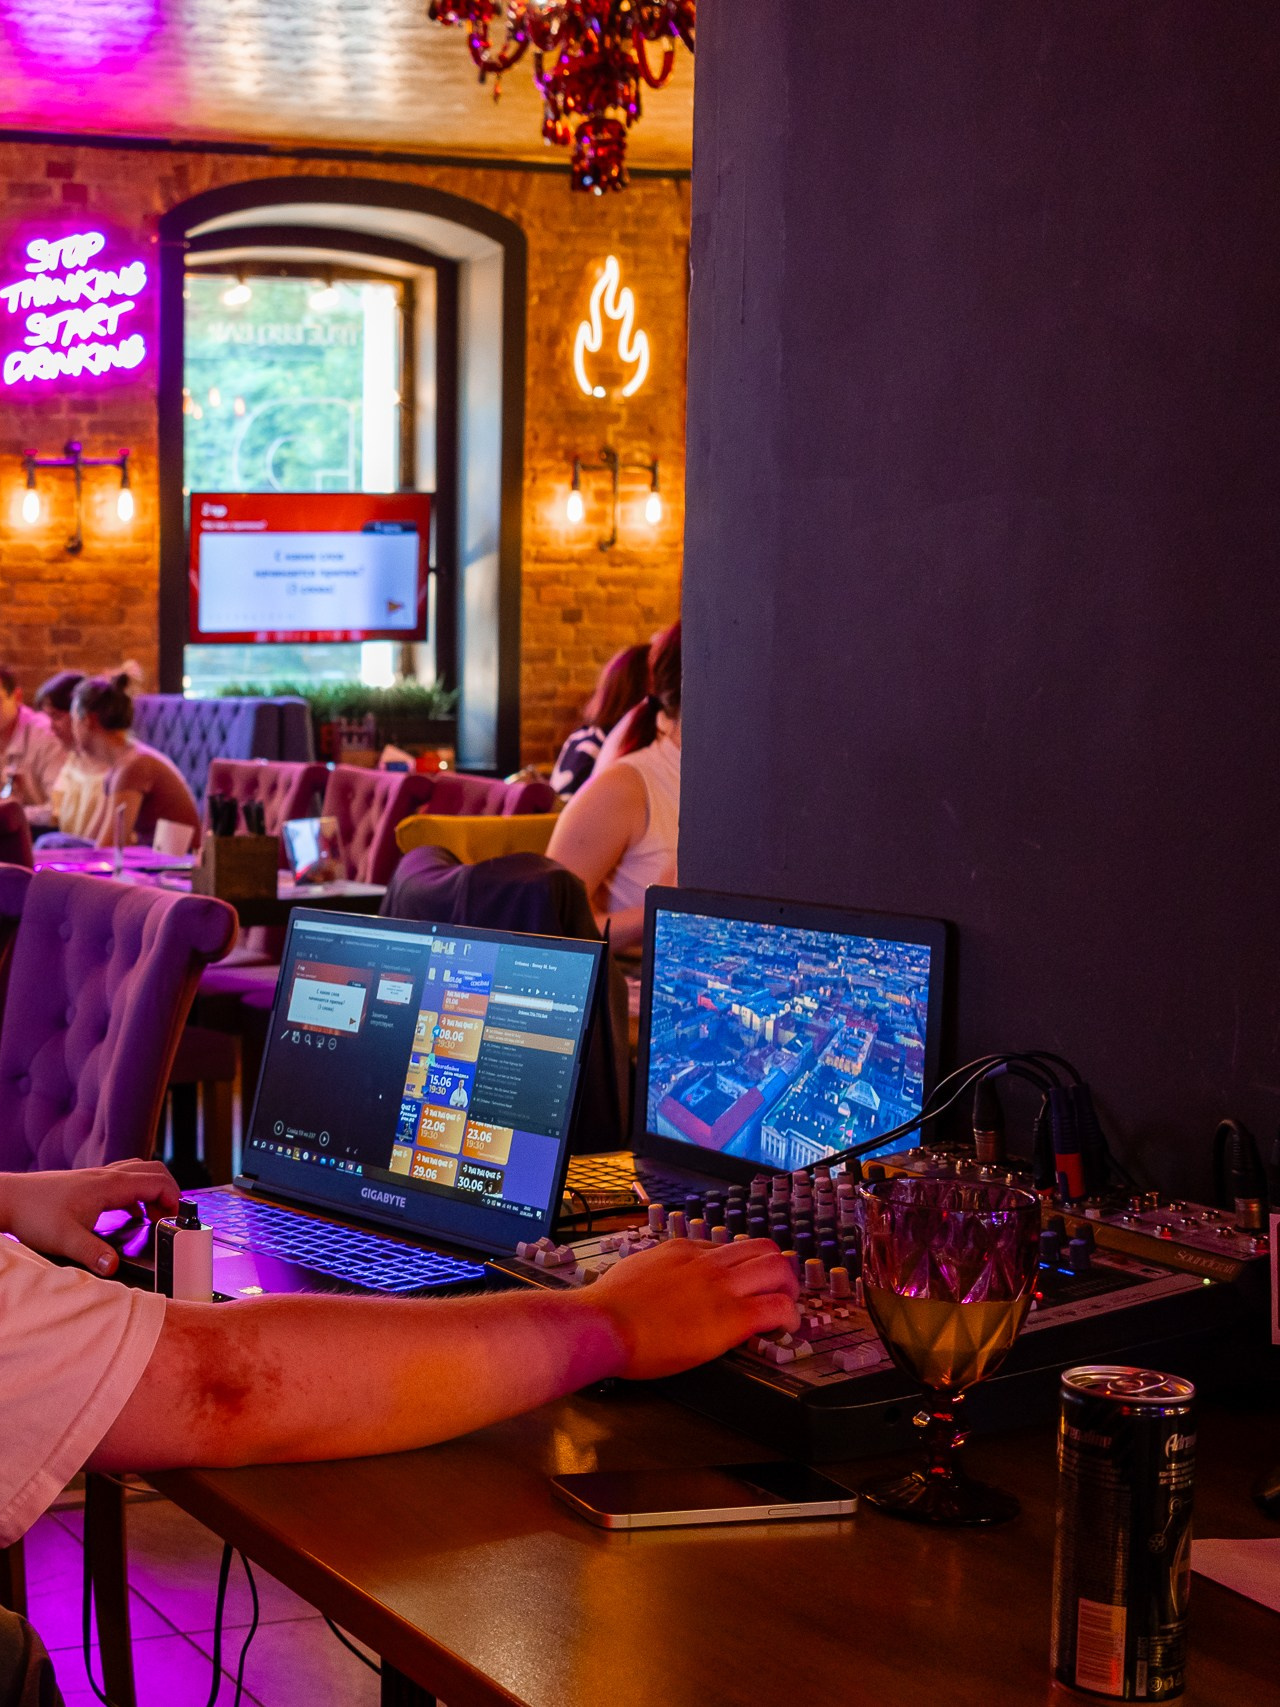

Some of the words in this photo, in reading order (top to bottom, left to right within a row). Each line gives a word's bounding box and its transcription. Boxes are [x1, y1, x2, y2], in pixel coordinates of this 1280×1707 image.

[25, 231, 105, 273] STOP
[0, 261, 147, 313] THINKING
[24, 300, 135, 346] START
[3, 334, 145, 385] DRINKING
[439, 1029, 464, 1042] 08.06
[430, 1074, 452, 1087] 15.06
[421, 1118, 445, 1133] 22.06
[421, 1129, 438, 1139] 19:30
[467, 1128, 492, 1142] 23.06
[466, 1139, 485, 1150] 19:30
[413, 1165, 437, 1179] 29.06
[457, 1176, 483, 1191] 30.06
[361, 1187, 407, 1208] GIGABYTE
[1175, 1250, 1236, 1274] Soundcraft
